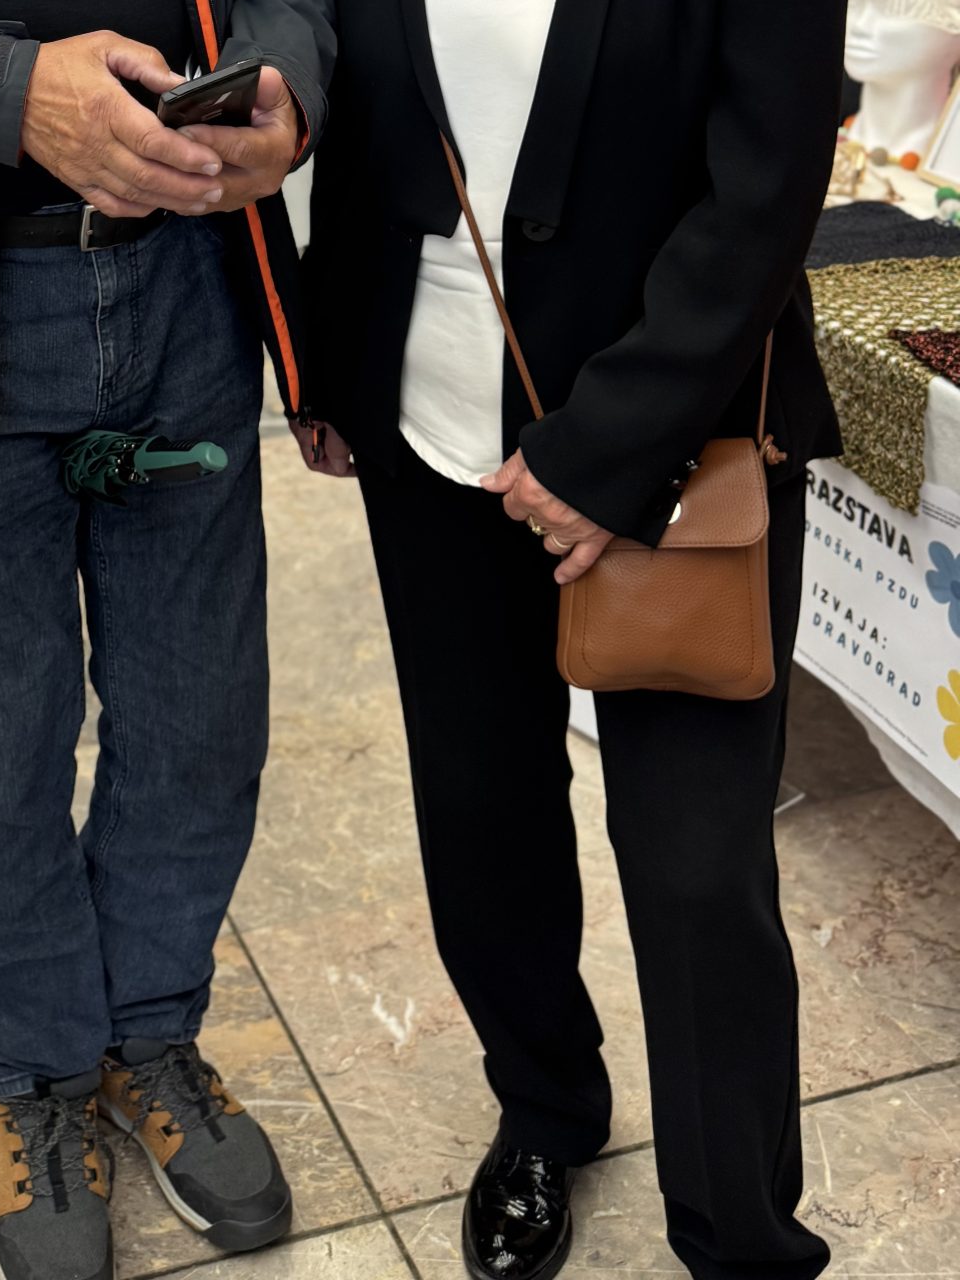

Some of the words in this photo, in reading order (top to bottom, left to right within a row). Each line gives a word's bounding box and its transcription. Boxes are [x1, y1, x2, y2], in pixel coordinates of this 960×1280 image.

[805, 467, 915, 565] RAZSTAVA
[805, 520, 863, 573] OROŠKA
[875, 570, 919, 609] PZDU
[812, 581, 888, 650] IZVAJA:
[812, 612, 922, 707] DRAVOGRAD
